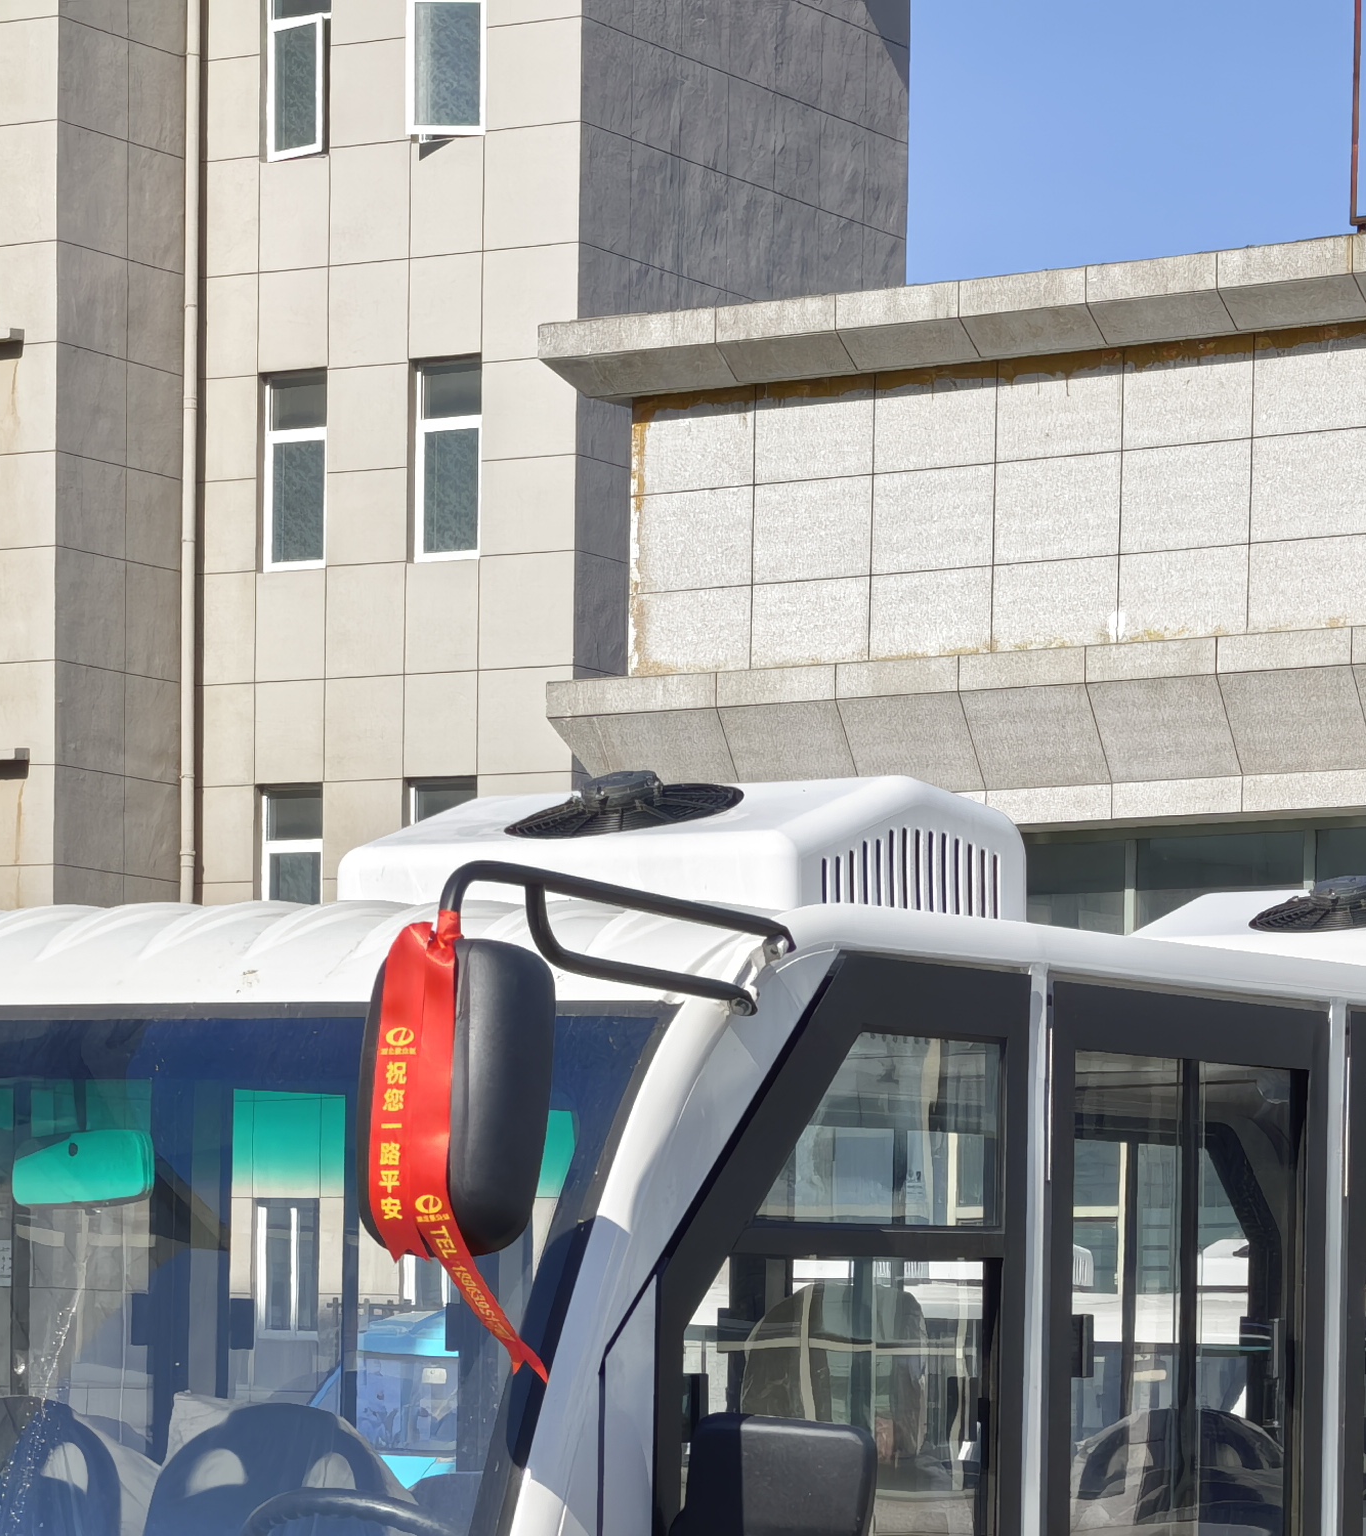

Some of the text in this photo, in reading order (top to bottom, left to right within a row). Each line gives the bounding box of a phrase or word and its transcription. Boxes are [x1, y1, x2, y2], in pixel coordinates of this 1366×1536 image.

[379, 1061, 407, 1220] 祝您一路平安
